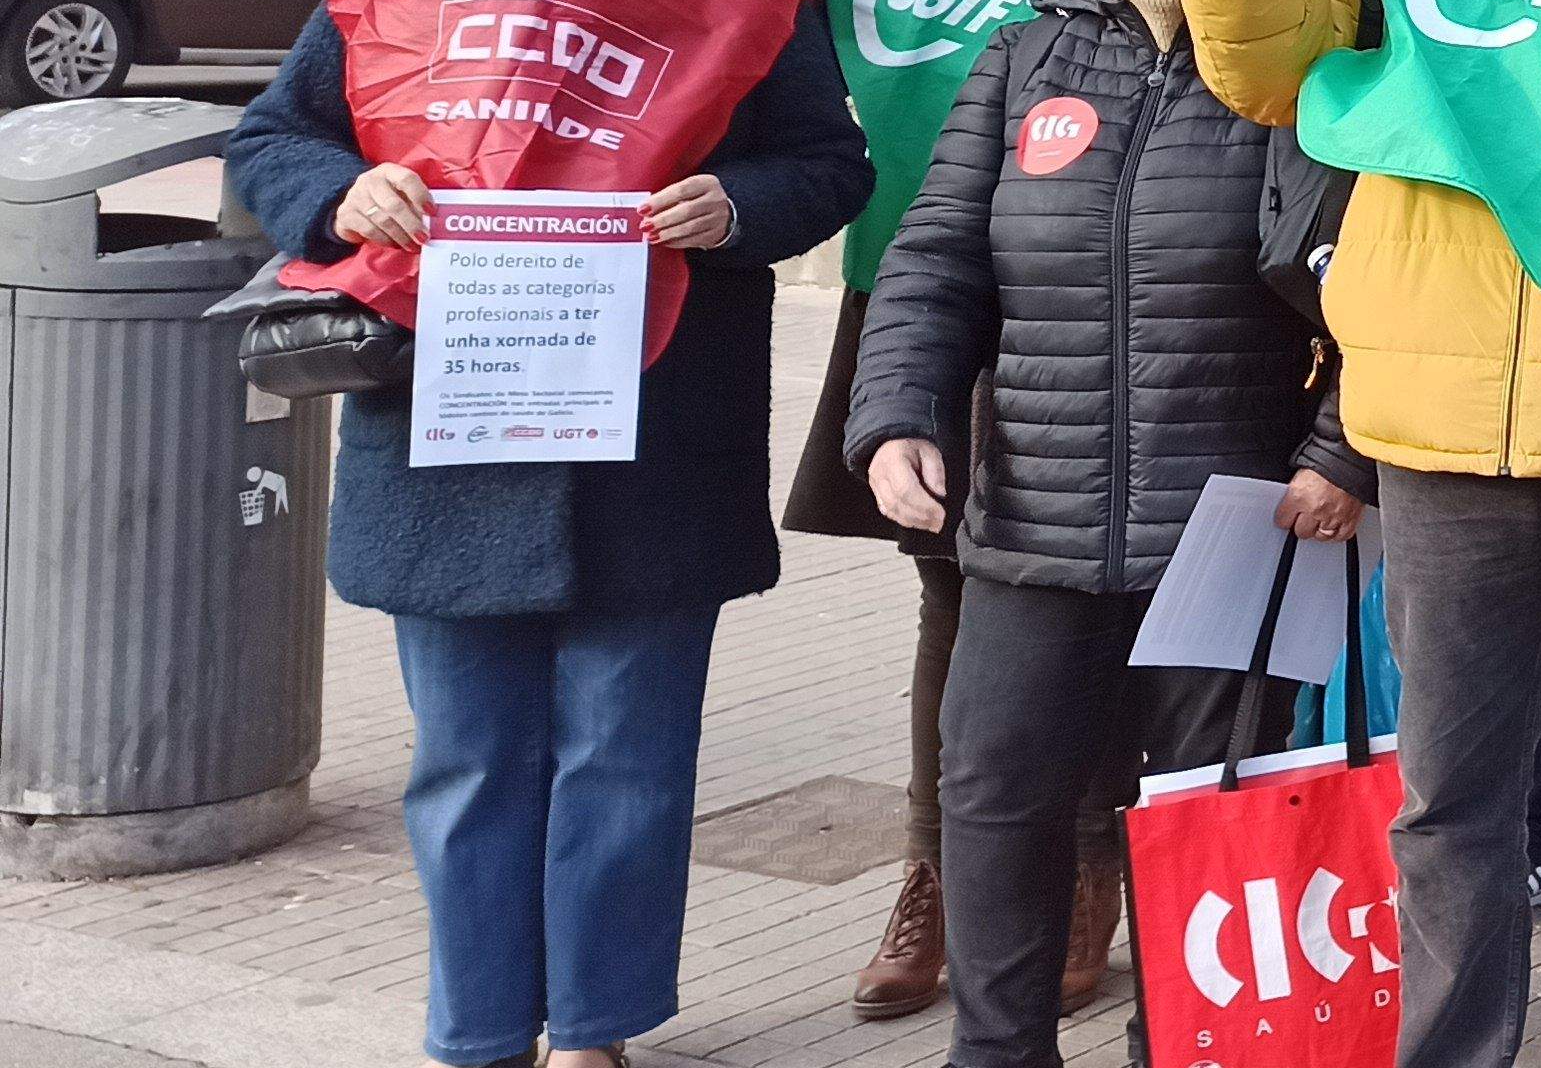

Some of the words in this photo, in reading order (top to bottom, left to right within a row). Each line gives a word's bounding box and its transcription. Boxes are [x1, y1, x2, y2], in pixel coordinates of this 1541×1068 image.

[446, 13, 645, 98] CCOO
[444, 213, 629, 235] CONCENTRACIÓN
[449, 252, 488, 268] Polo
[493, 253, 557, 269] dereito
[562, 254, 585, 269] de
[448, 281, 497, 295] todas
[502, 284, 521, 295] as
[525, 280, 616, 298] categorías
[445, 306, 554, 324] profesionais
[558, 310, 569, 320] a
[574, 307, 601, 321] ter
[444, 333, 491, 349] unha
[495, 332, 569, 348] xornada
[574, 331, 597, 347] de
[443, 359, 465, 375] 35
[552, 428, 584, 440] UGT
